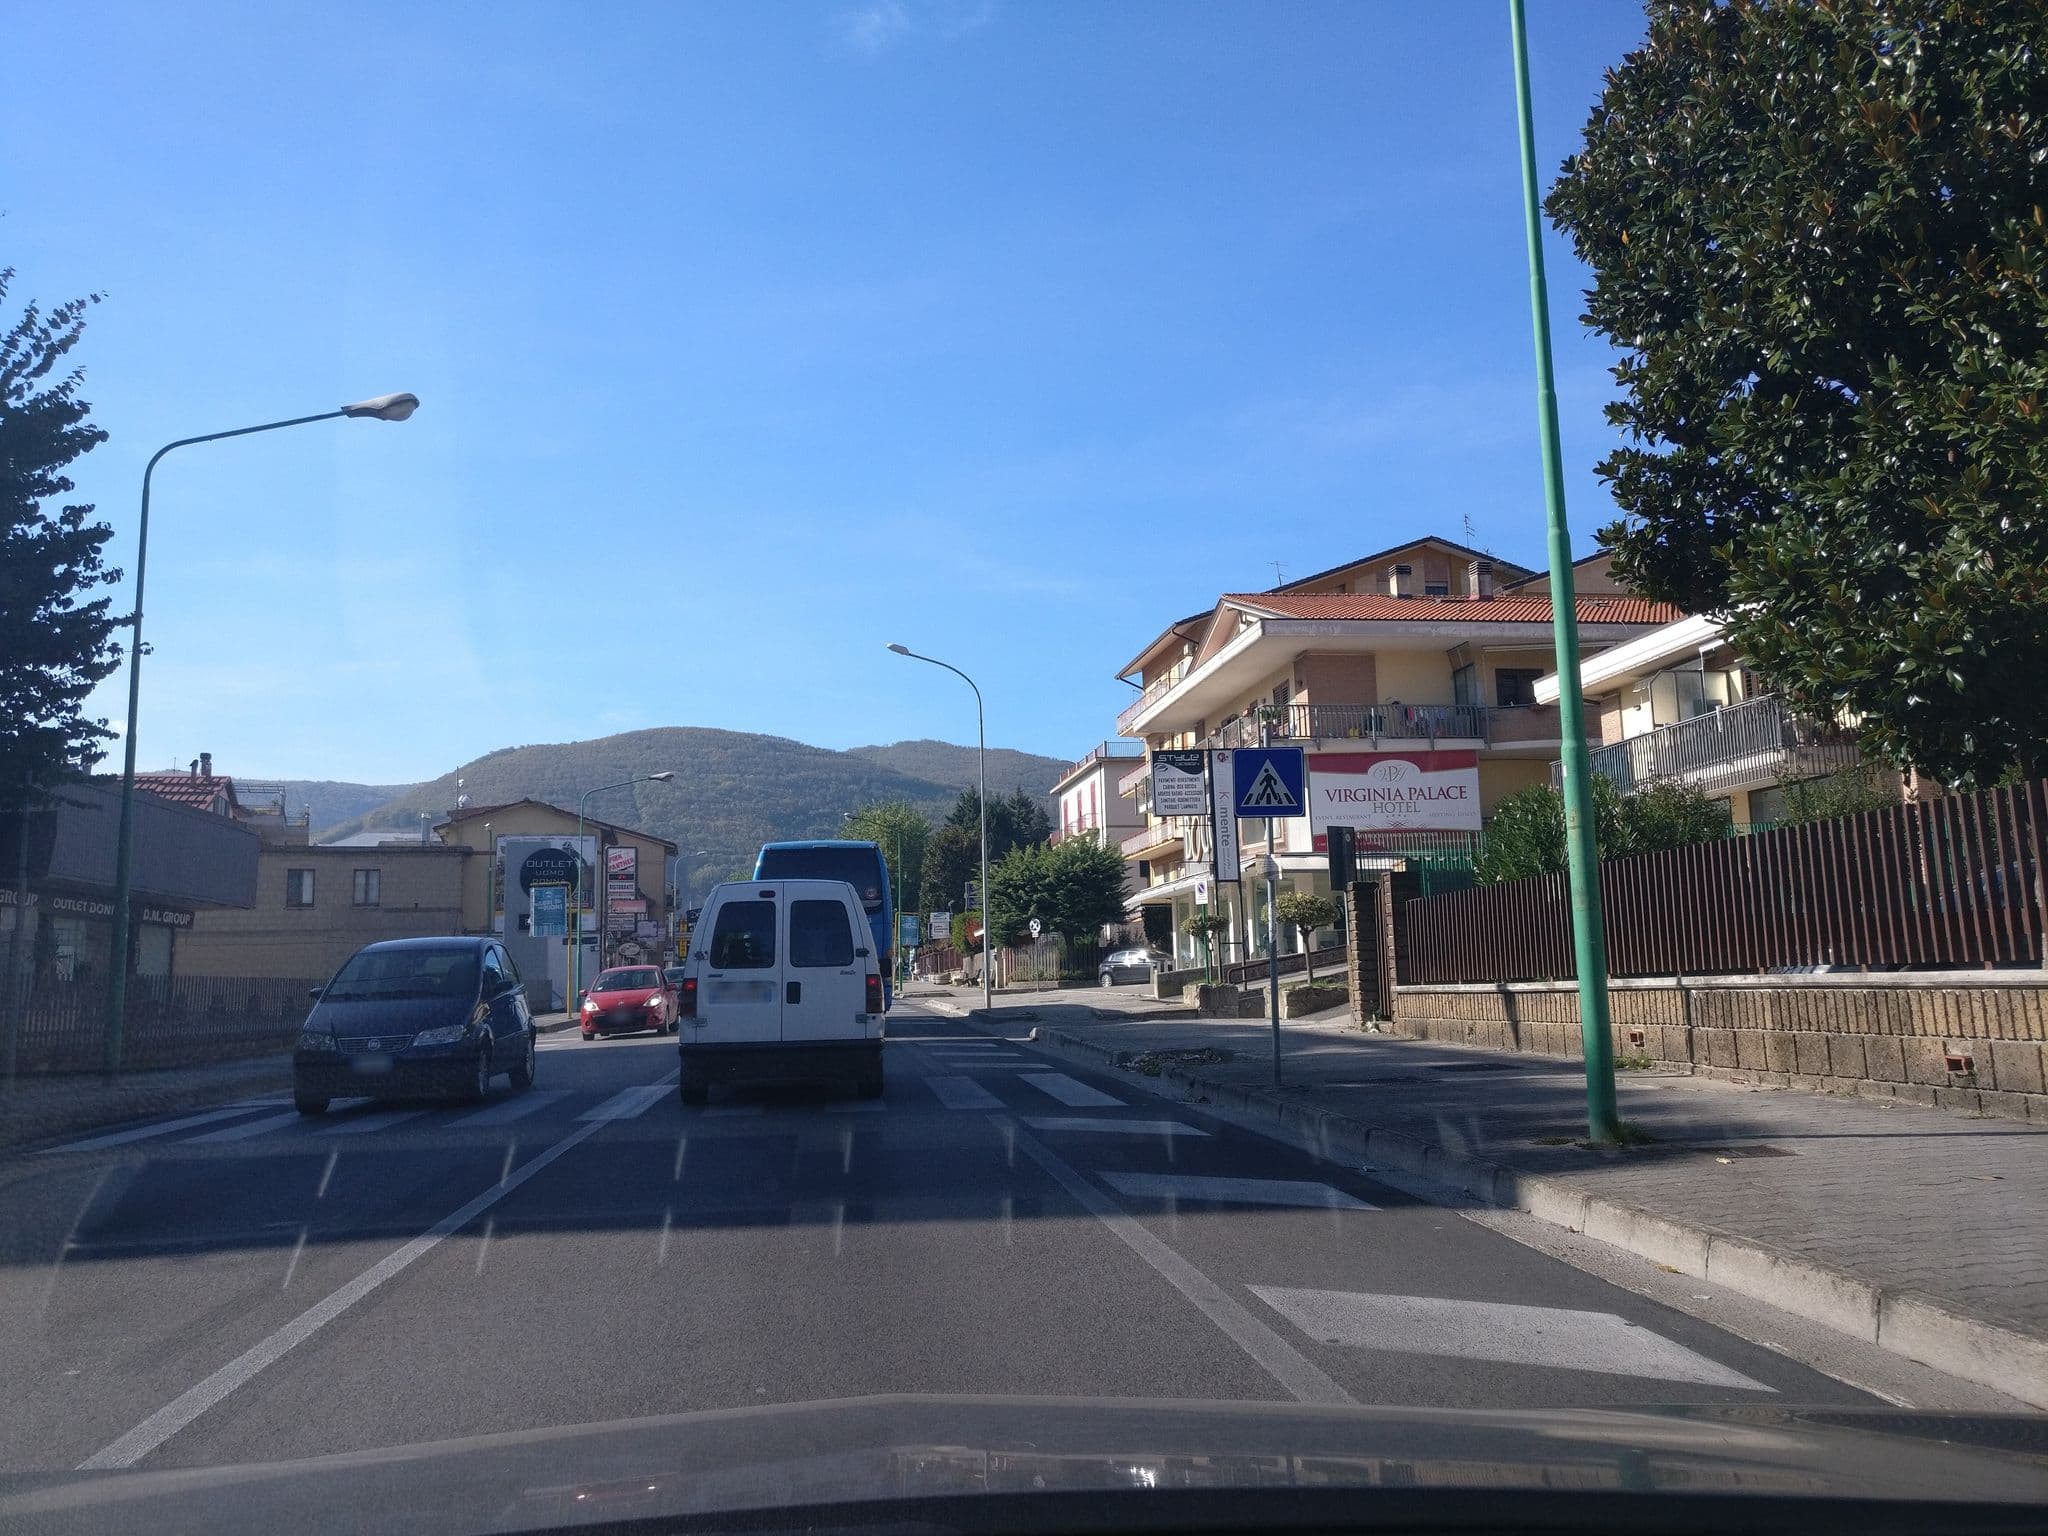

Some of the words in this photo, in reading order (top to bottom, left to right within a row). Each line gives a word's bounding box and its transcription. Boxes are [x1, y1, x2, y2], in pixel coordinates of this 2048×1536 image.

[1325, 787, 1407, 803] VIRGINIA
[1407, 785, 1468, 802] PALACE
[1373, 801, 1422, 814] HOTEL
[526, 860, 574, 868] OUTLET
[53, 897, 88, 912] OUTLET
[163, 910, 192, 927] GROUP
